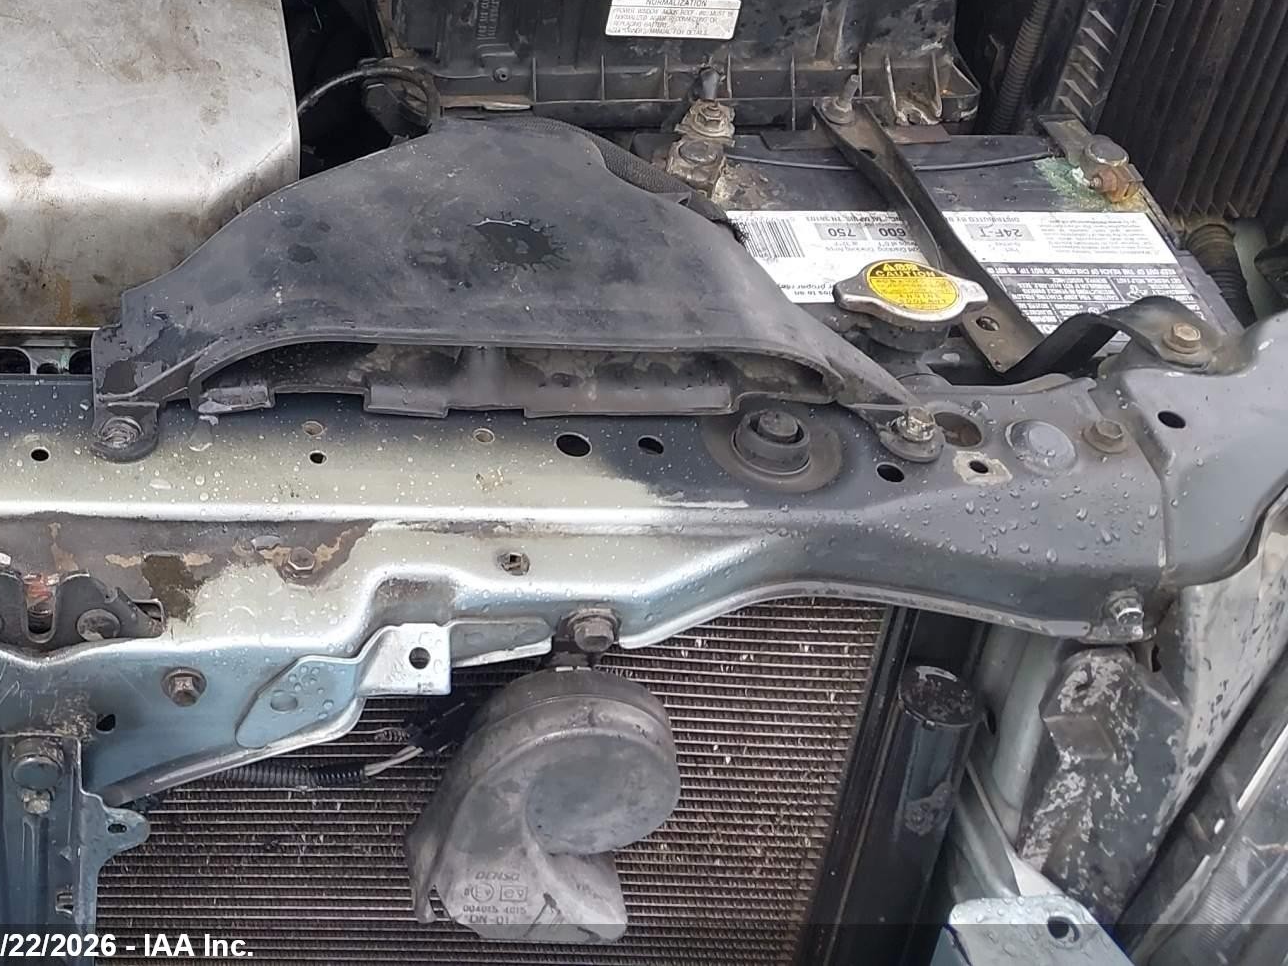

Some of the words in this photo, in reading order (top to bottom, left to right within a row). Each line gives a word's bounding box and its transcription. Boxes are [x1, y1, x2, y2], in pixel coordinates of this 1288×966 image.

[827, 227, 857, 238] 750
[878, 227, 906, 238] 600
[979, 228, 1023, 238] 24F-T
[874, 269, 936, 278] CAUTION
[475, 870, 521, 882] DENSO
